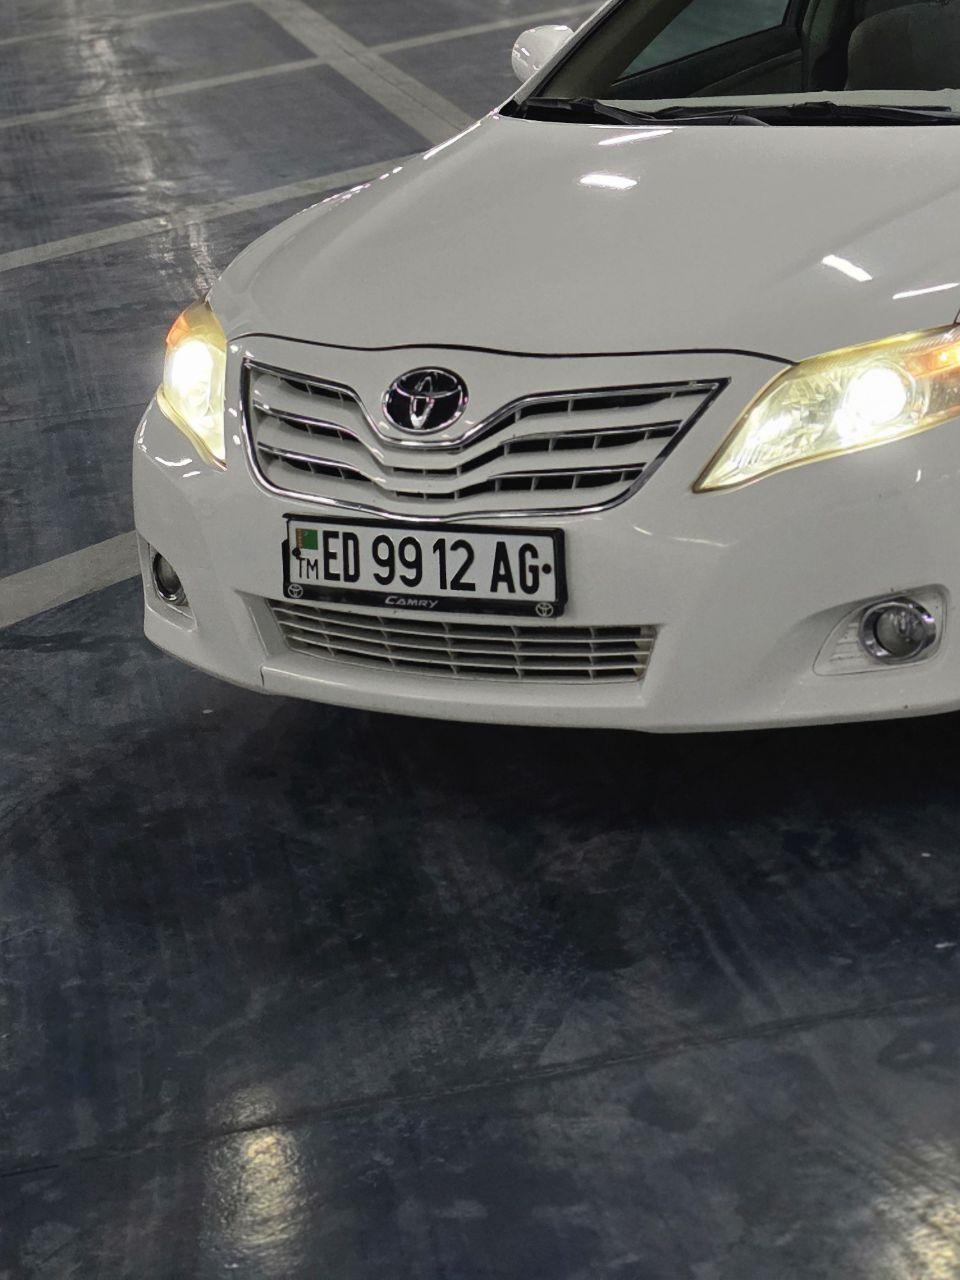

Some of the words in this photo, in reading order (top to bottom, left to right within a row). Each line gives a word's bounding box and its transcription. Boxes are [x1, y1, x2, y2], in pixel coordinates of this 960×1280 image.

[298, 556, 319, 580] TM
[322, 530, 361, 583] ED
[371, 534, 476, 592] 9912
[489, 541, 540, 595] AG
[385, 595, 439, 609] CAMRY
